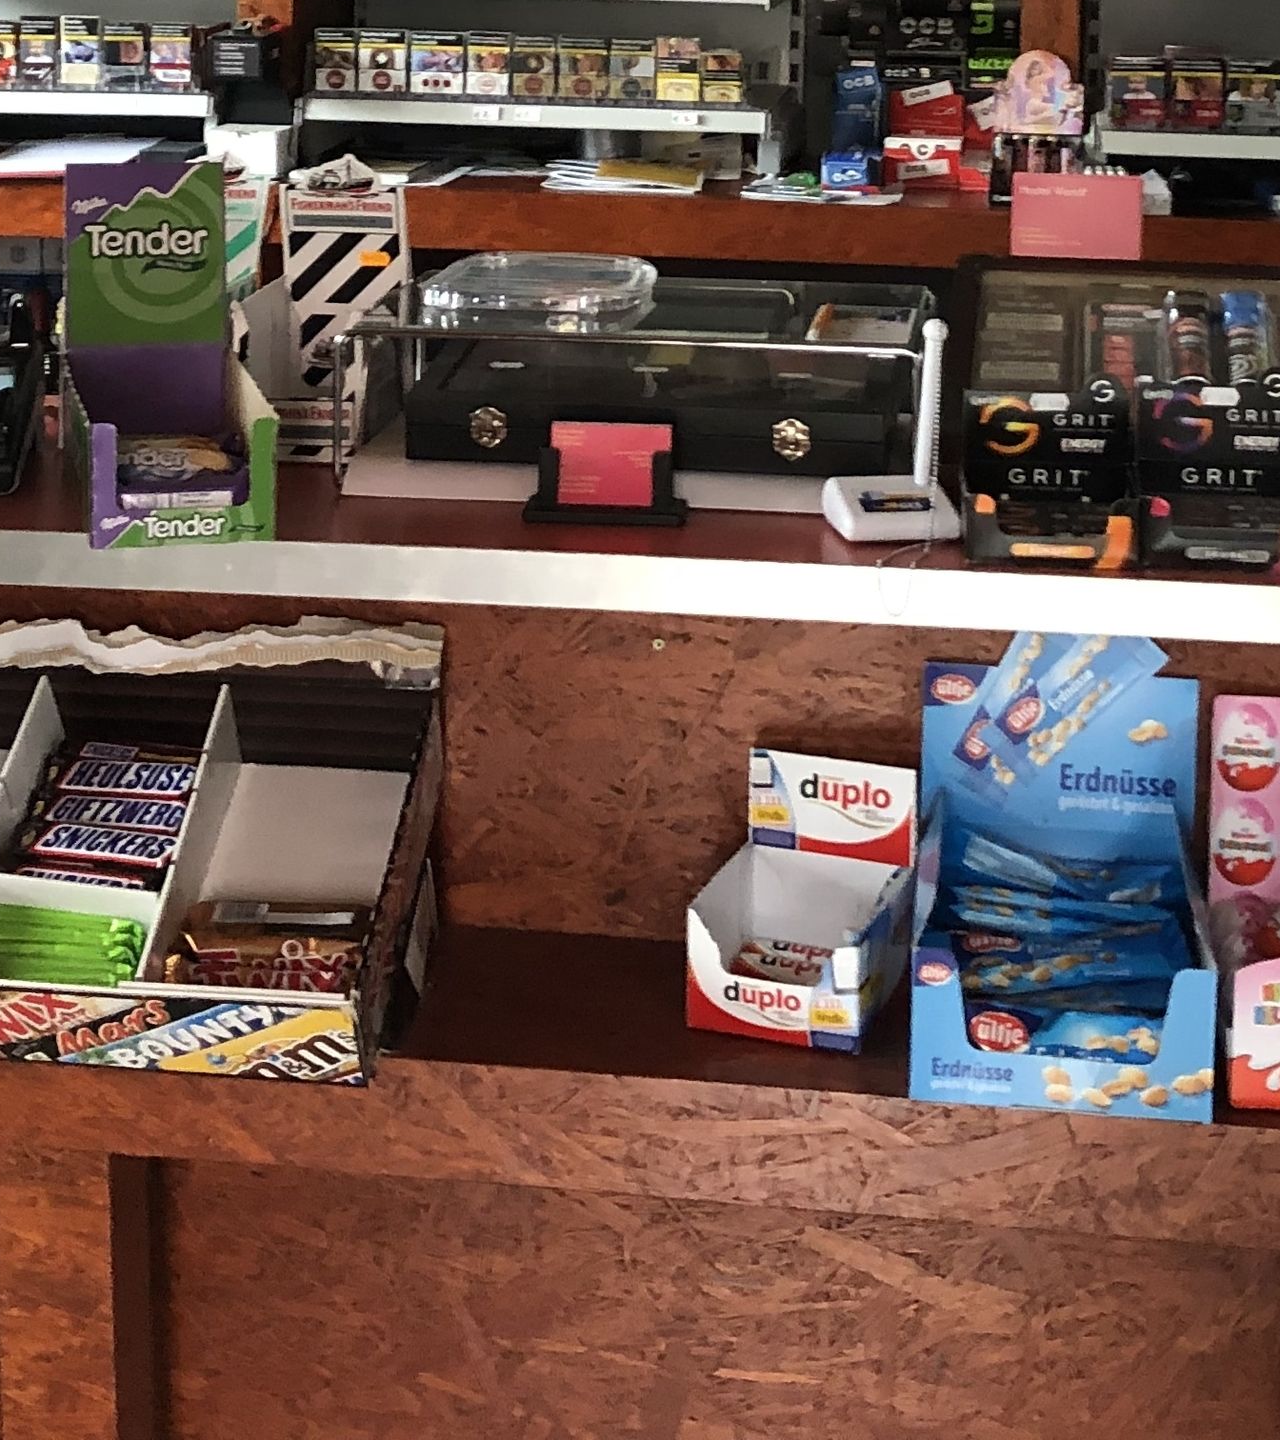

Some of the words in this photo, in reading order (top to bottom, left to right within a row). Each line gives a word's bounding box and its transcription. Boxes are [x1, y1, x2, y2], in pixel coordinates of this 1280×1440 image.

[899, 16, 955, 35] OCB
[842, 74, 875, 90] OCB
[84, 223, 209, 258] Tender
[1052, 412, 1116, 428] GRIT
[1007, 468, 1091, 486] GRIT
[1180, 466, 1263, 486] GRIT
[142, 513, 227, 538] Tender
[66, 760, 197, 792] HEULSUSE
[1059, 763, 1177, 799] Erdnüsse
[800, 772, 892, 810] duplo
[41, 824, 176, 860] SNICKERS
[723, 980, 802, 1012] duplo
[108, 1004, 275, 1068] BOUNTY
[976, 1019, 1028, 1046] ültje
[930, 1056, 1015, 1082] Erdnüsse
